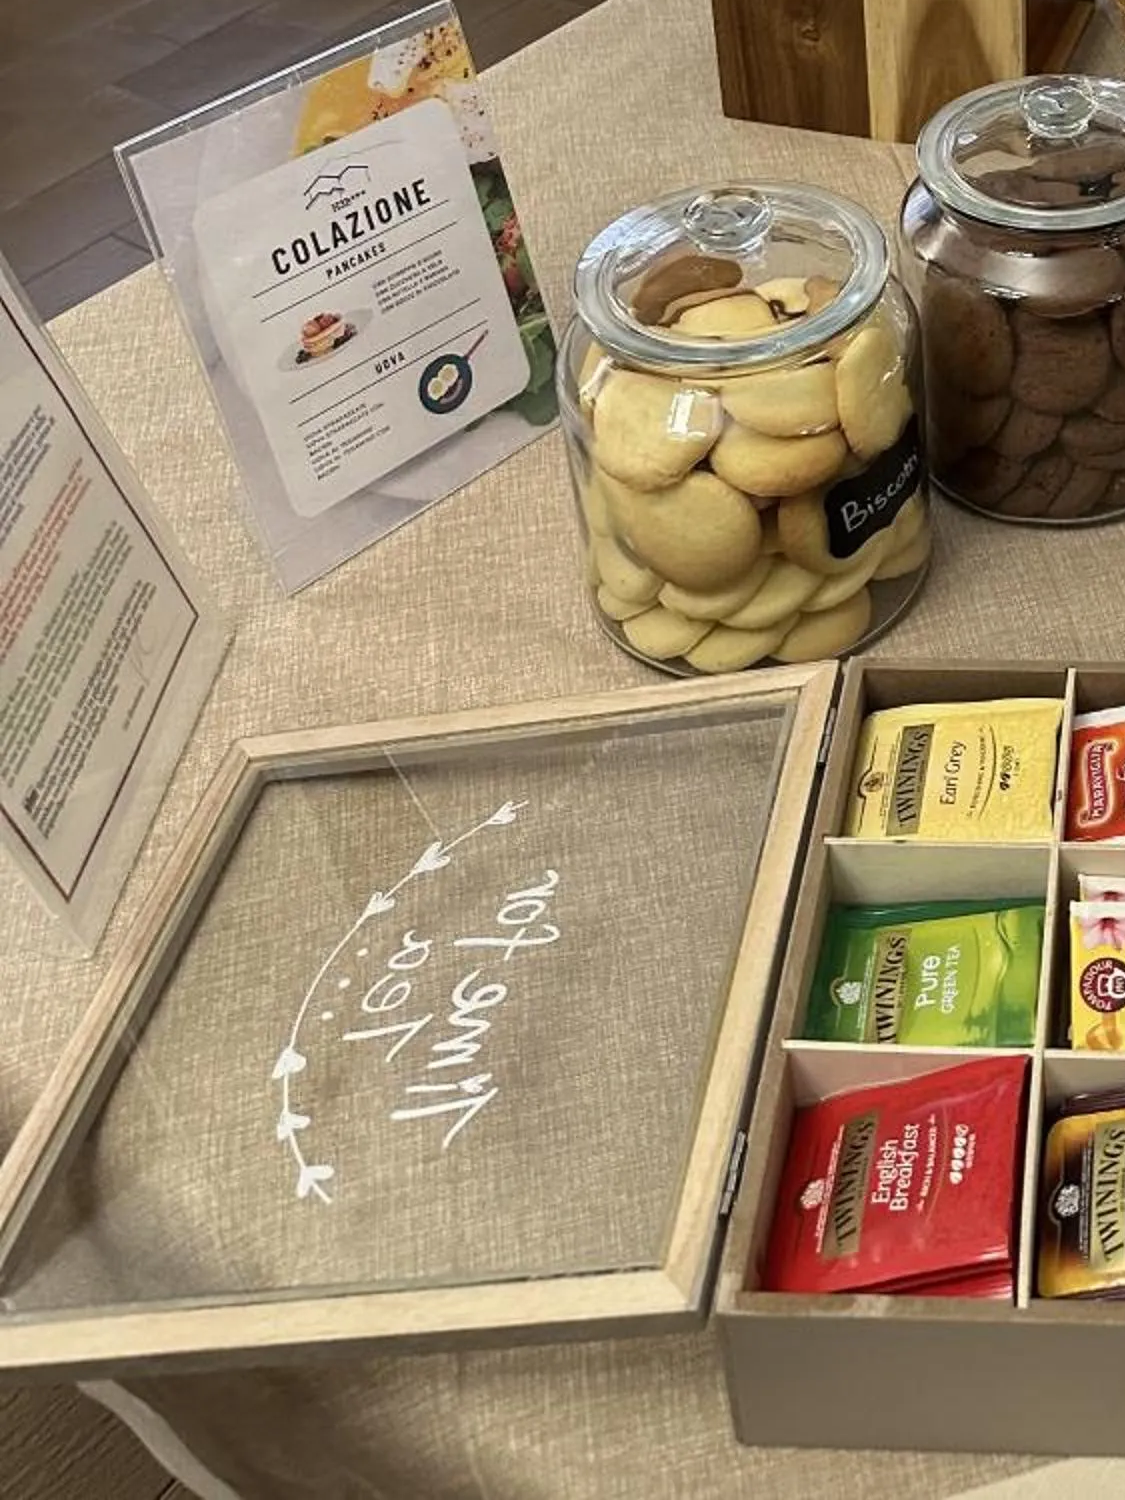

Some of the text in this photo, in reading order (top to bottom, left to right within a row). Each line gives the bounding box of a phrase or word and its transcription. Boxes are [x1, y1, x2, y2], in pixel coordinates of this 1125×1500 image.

[271, 178, 431, 275] COLAZIONE
[325, 242, 387, 280] PANCAKES
[375, 351, 405, 374] UOVA
[896, 730, 930, 827] TWININGS
[939, 739, 968, 806] Earl Grey
[876, 935, 907, 1044] TWININGS
[915, 955, 941, 1010] Pure
[834, 1120, 875, 1247] TWININGS
[871, 1139, 899, 1205] English
[889, 1123, 921, 1211] Breakfast
